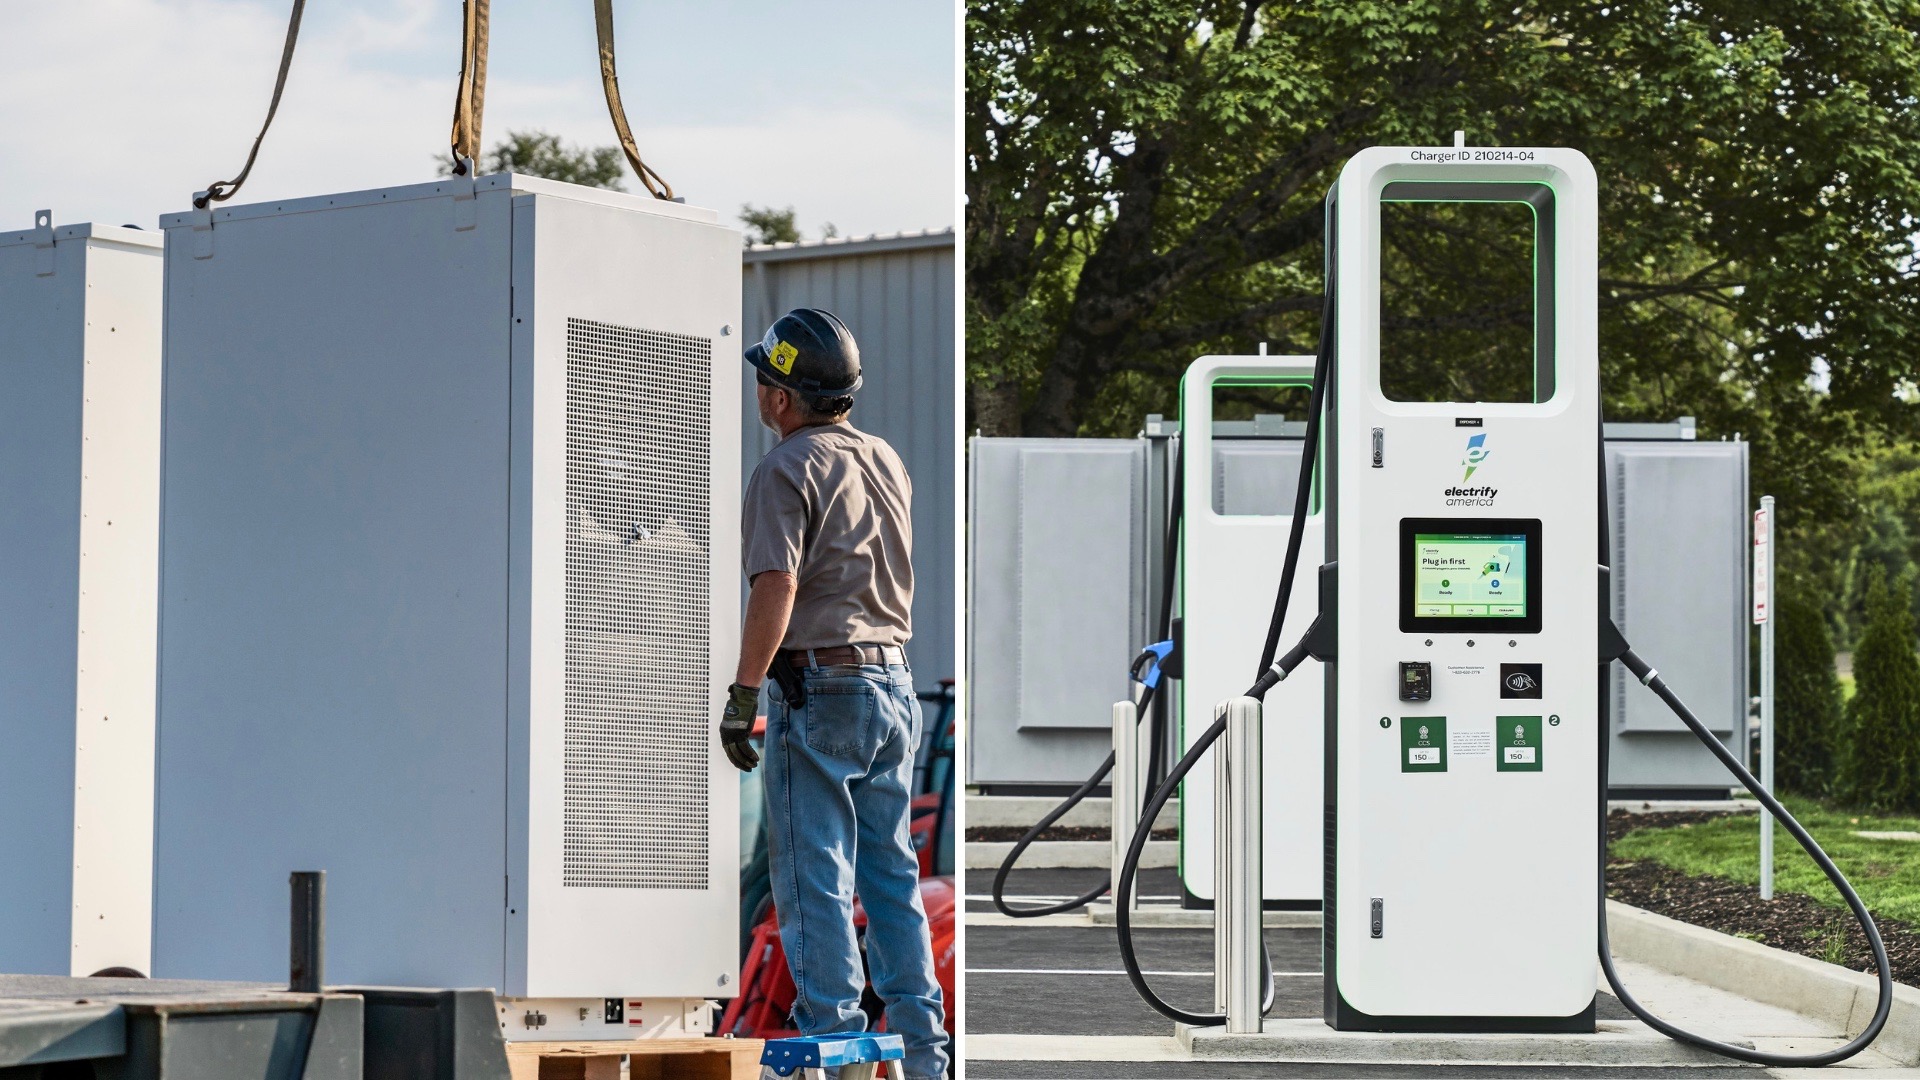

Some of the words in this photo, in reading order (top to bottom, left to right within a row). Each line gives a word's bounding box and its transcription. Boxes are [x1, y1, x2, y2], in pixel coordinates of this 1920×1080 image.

[1410, 150, 1456, 163] Charger
[1458, 151, 1470, 161] ID
[1474, 151, 1535, 161] 210214-04
[1444, 486, 1498, 499] electrify
[1446, 497, 1494, 507] america
[1422, 558, 1440, 566] Plug
[1449, 557, 1466, 565] first
